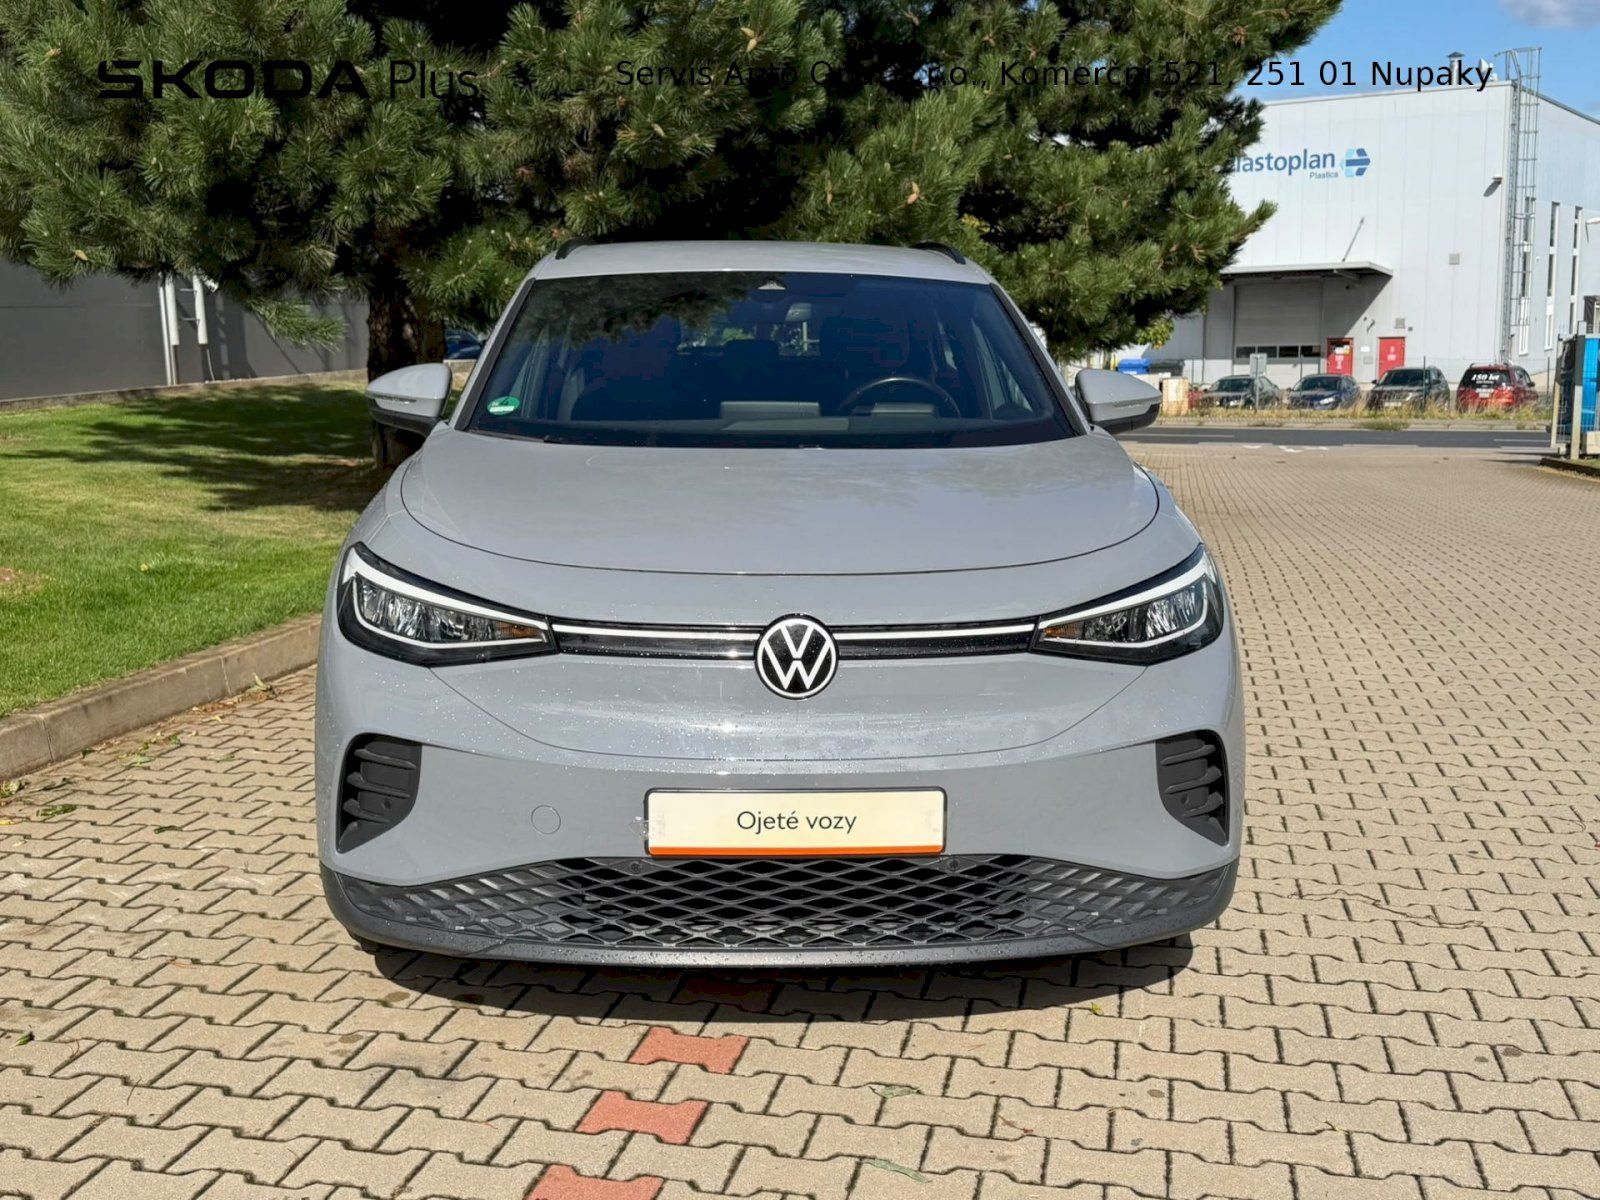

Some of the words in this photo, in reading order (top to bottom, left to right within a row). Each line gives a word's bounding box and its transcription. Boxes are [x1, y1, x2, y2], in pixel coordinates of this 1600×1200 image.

[1229, 148, 1335, 176] lastoplan
[736, 810, 799, 835] Ojeté
[805, 815, 857, 834] vozy
